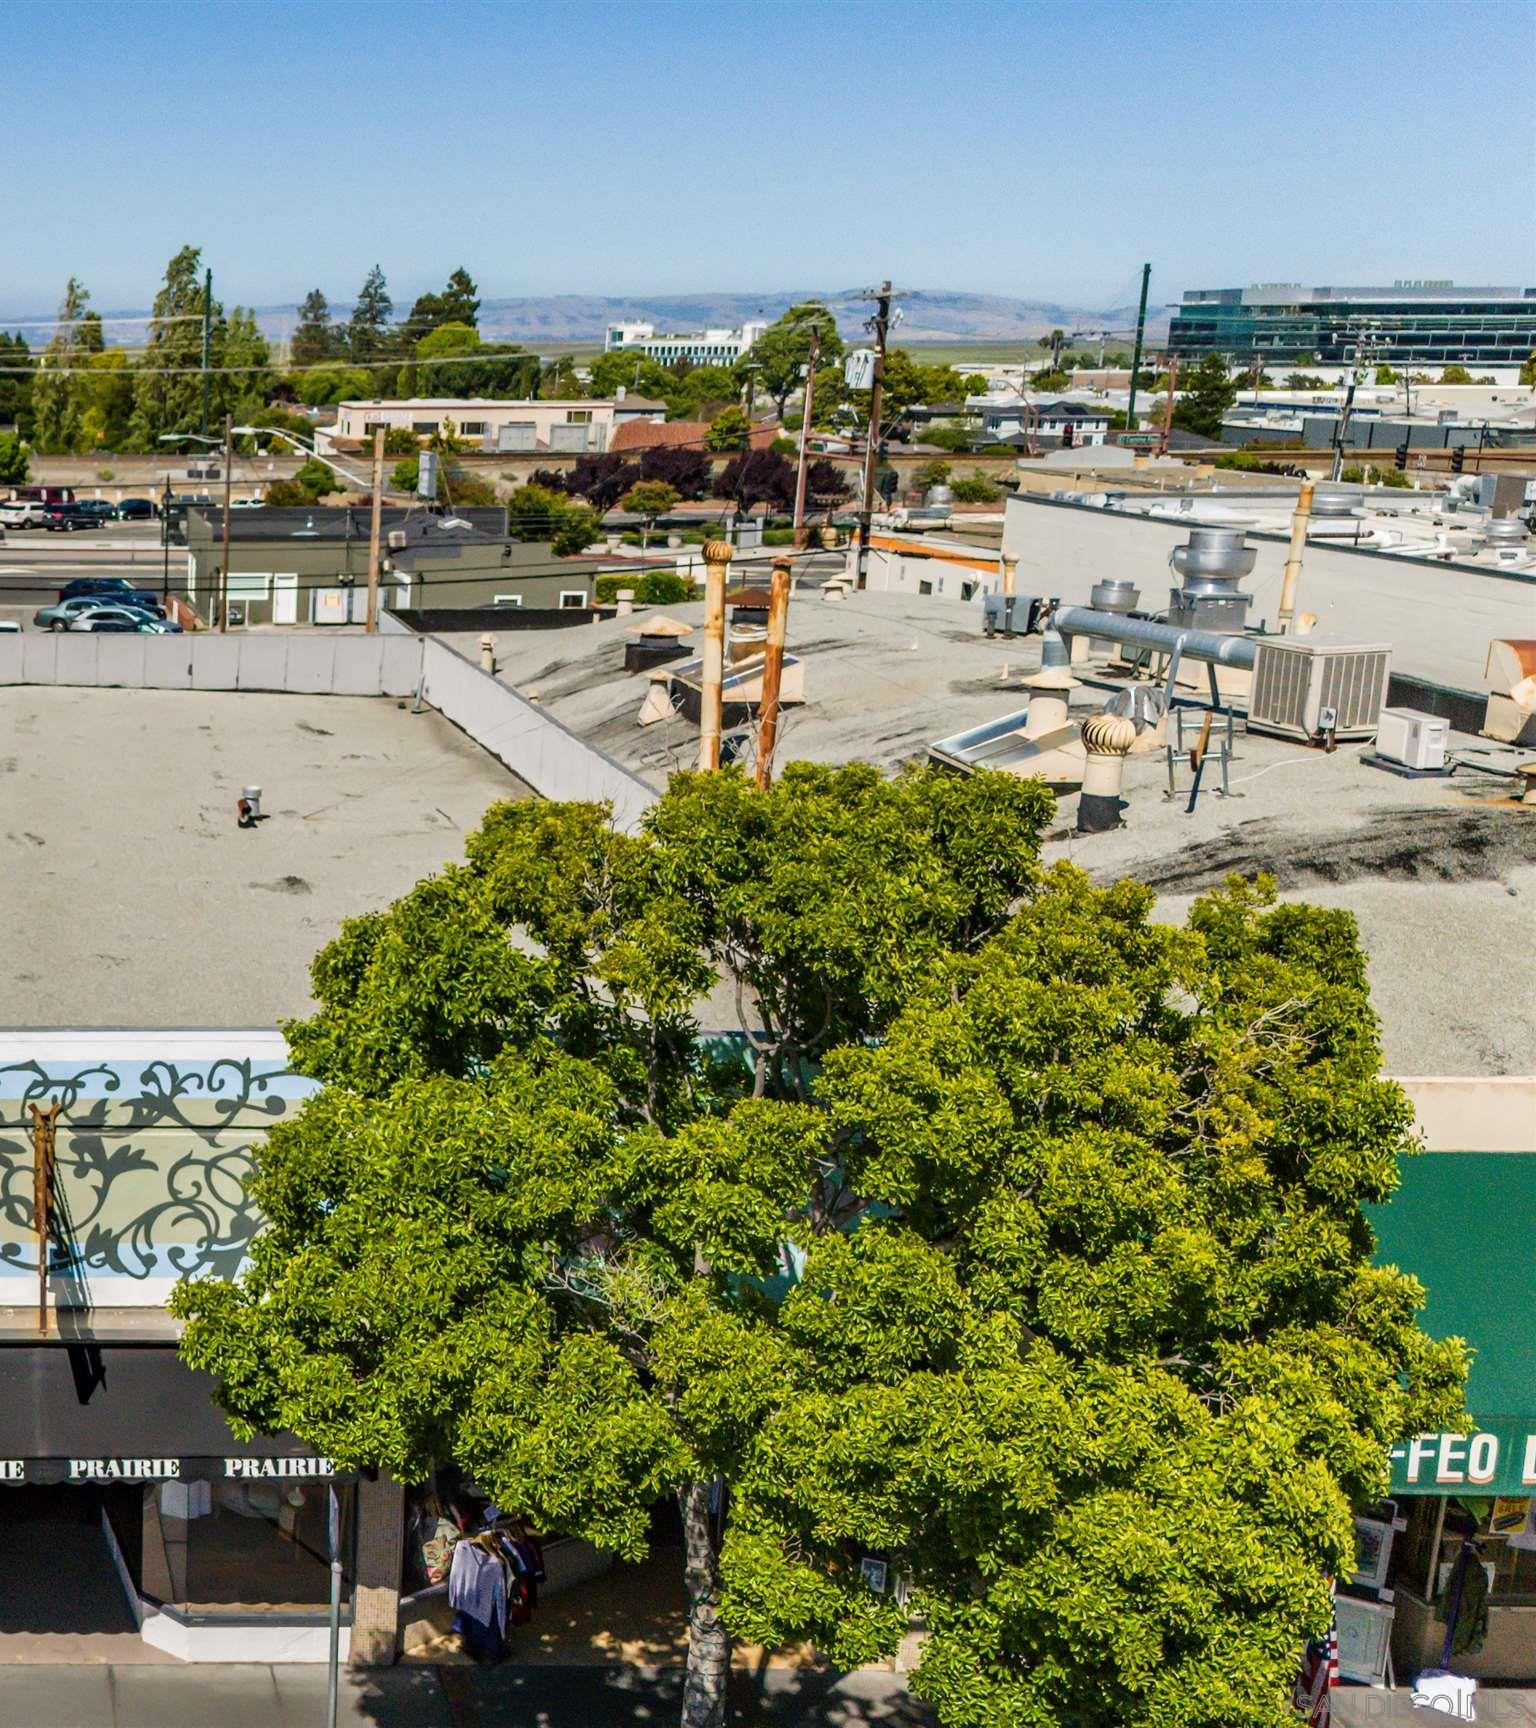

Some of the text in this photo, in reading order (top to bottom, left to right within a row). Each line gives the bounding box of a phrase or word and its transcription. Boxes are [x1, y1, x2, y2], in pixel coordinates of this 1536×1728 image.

[68, 1458, 181, 1478] PRAIRIE
[224, 1456, 335, 1477] PRAIRIE
[1390, 1433, 1498, 1484] FEO
